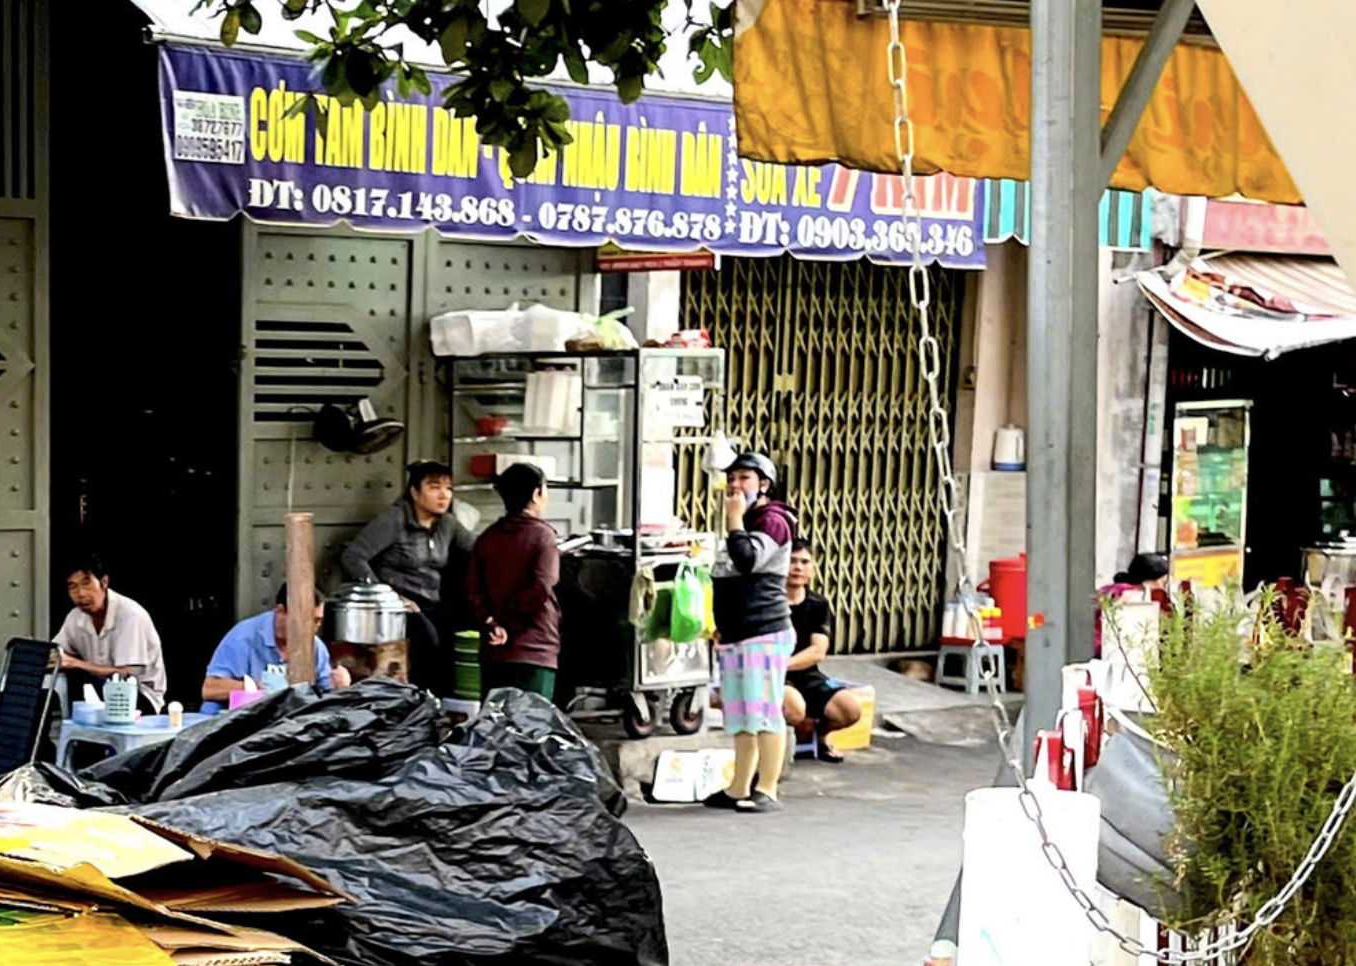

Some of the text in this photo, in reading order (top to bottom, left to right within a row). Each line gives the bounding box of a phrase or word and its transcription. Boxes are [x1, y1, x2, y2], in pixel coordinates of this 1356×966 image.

[368, 89, 428, 174] BÌNH
[561, 109, 622, 202] NHẬU
[624, 115, 677, 195] BÌNH
[679, 120, 724, 199] DÂN
[248, 177, 304, 211] ĐT:
[311, 183, 516, 226] 0817.143.868
[538, 201, 722, 241] 0787.876.878
[739, 210, 791, 246] ĐT:
